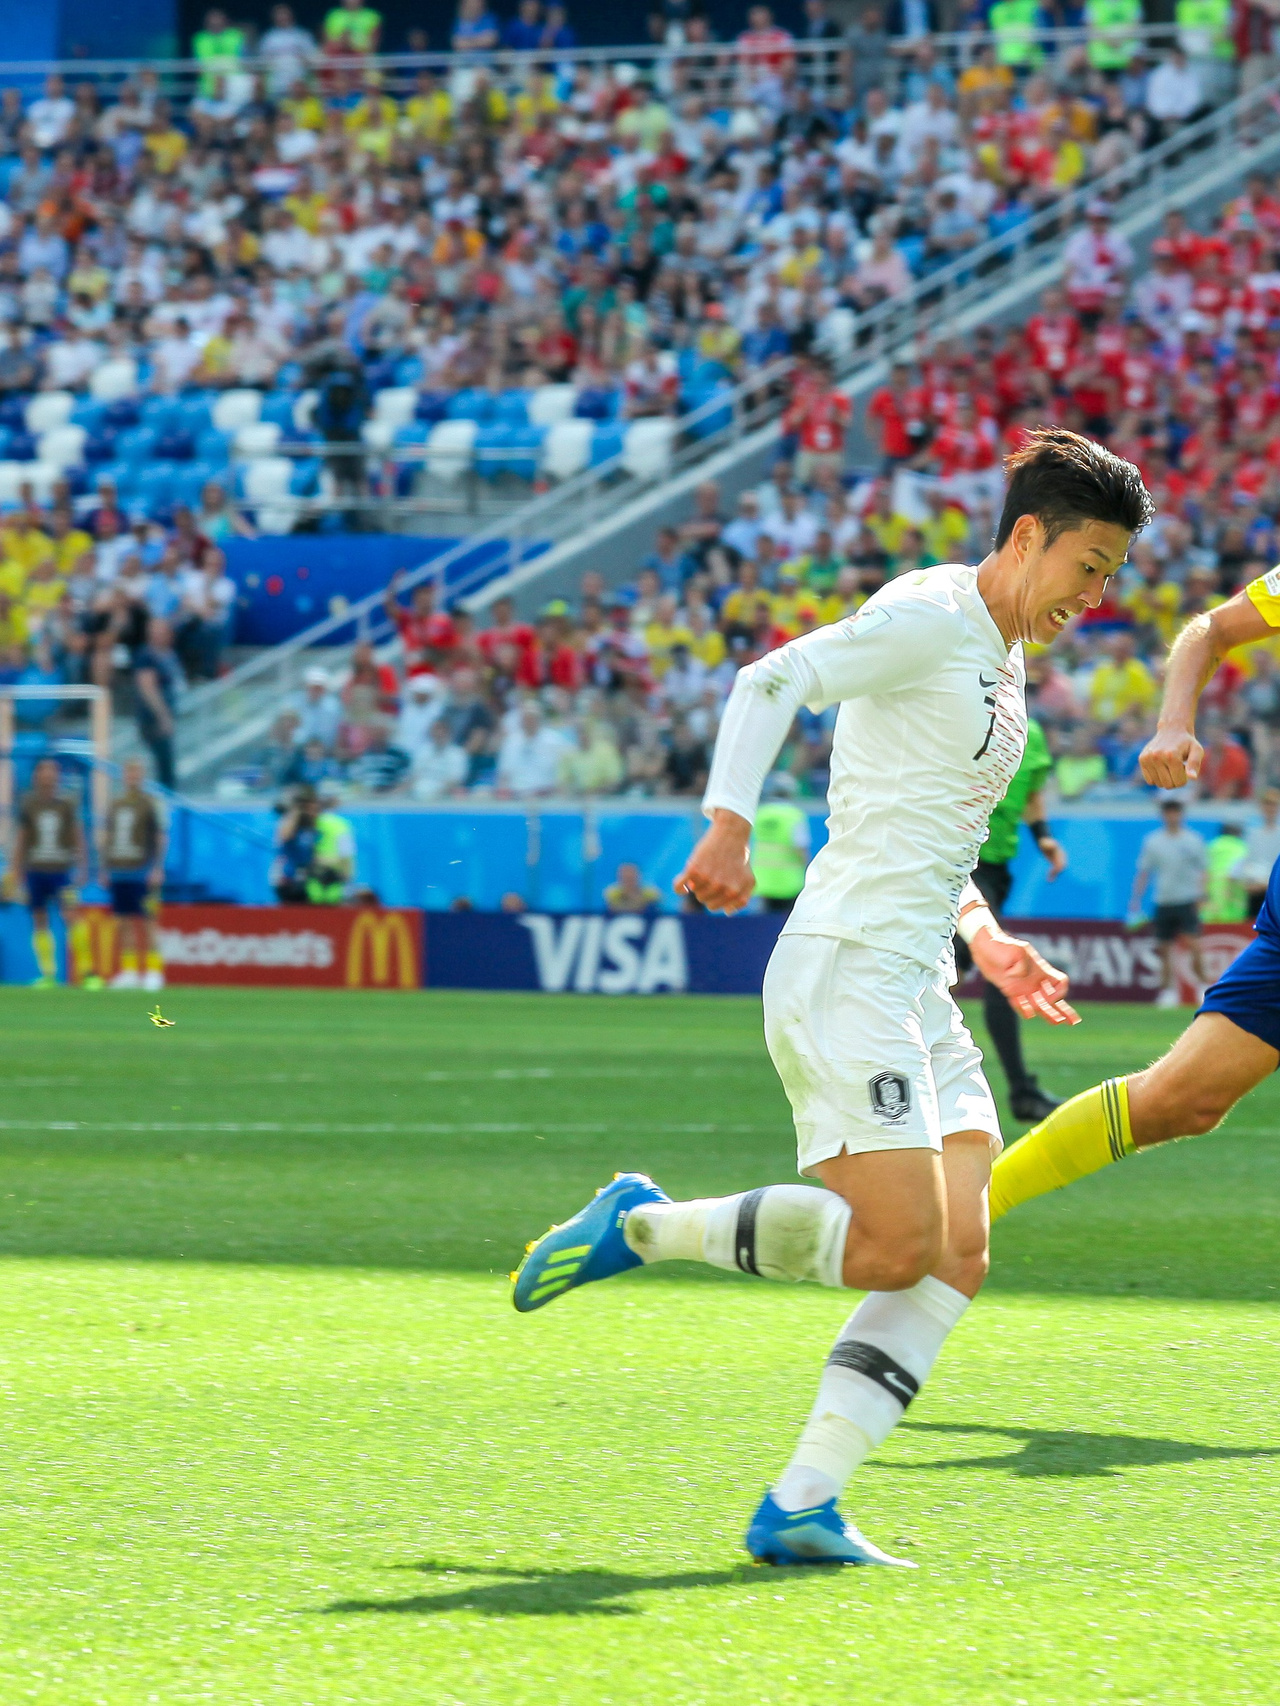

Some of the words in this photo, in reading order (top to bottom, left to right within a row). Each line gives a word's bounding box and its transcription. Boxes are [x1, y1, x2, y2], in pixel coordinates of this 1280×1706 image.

[972, 695, 997, 761] 7
[517, 914, 688, 992] VISA
[1015, 933, 1164, 988] WAYS
